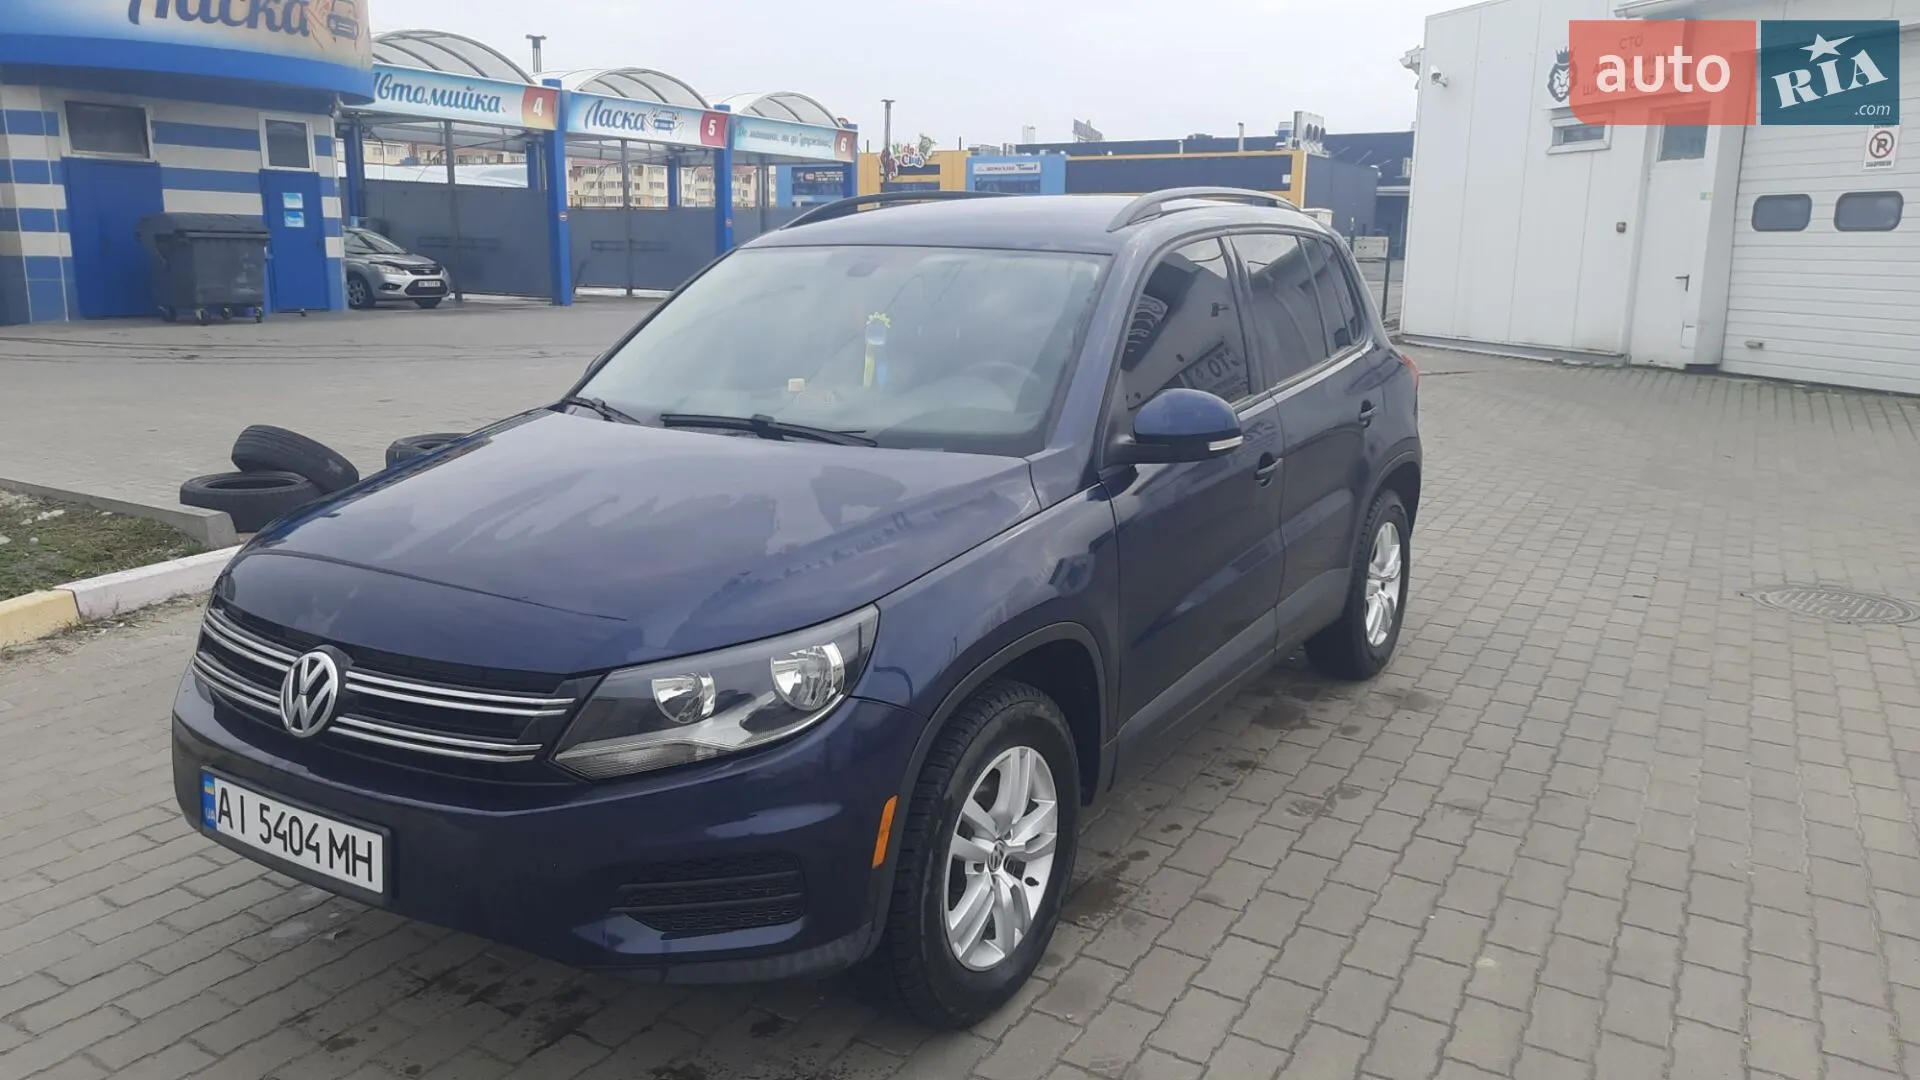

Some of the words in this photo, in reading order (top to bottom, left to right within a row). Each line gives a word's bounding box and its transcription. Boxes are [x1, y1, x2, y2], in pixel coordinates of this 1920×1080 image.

[532, 97, 543, 117] 4
[584, 100, 646, 132] Ласка
[707, 119, 717, 136] 5
[840, 137, 848, 152] 6
[217, 786, 246, 835] AI
[259, 802, 321, 865] 5404
[328, 827, 373, 883] MH
